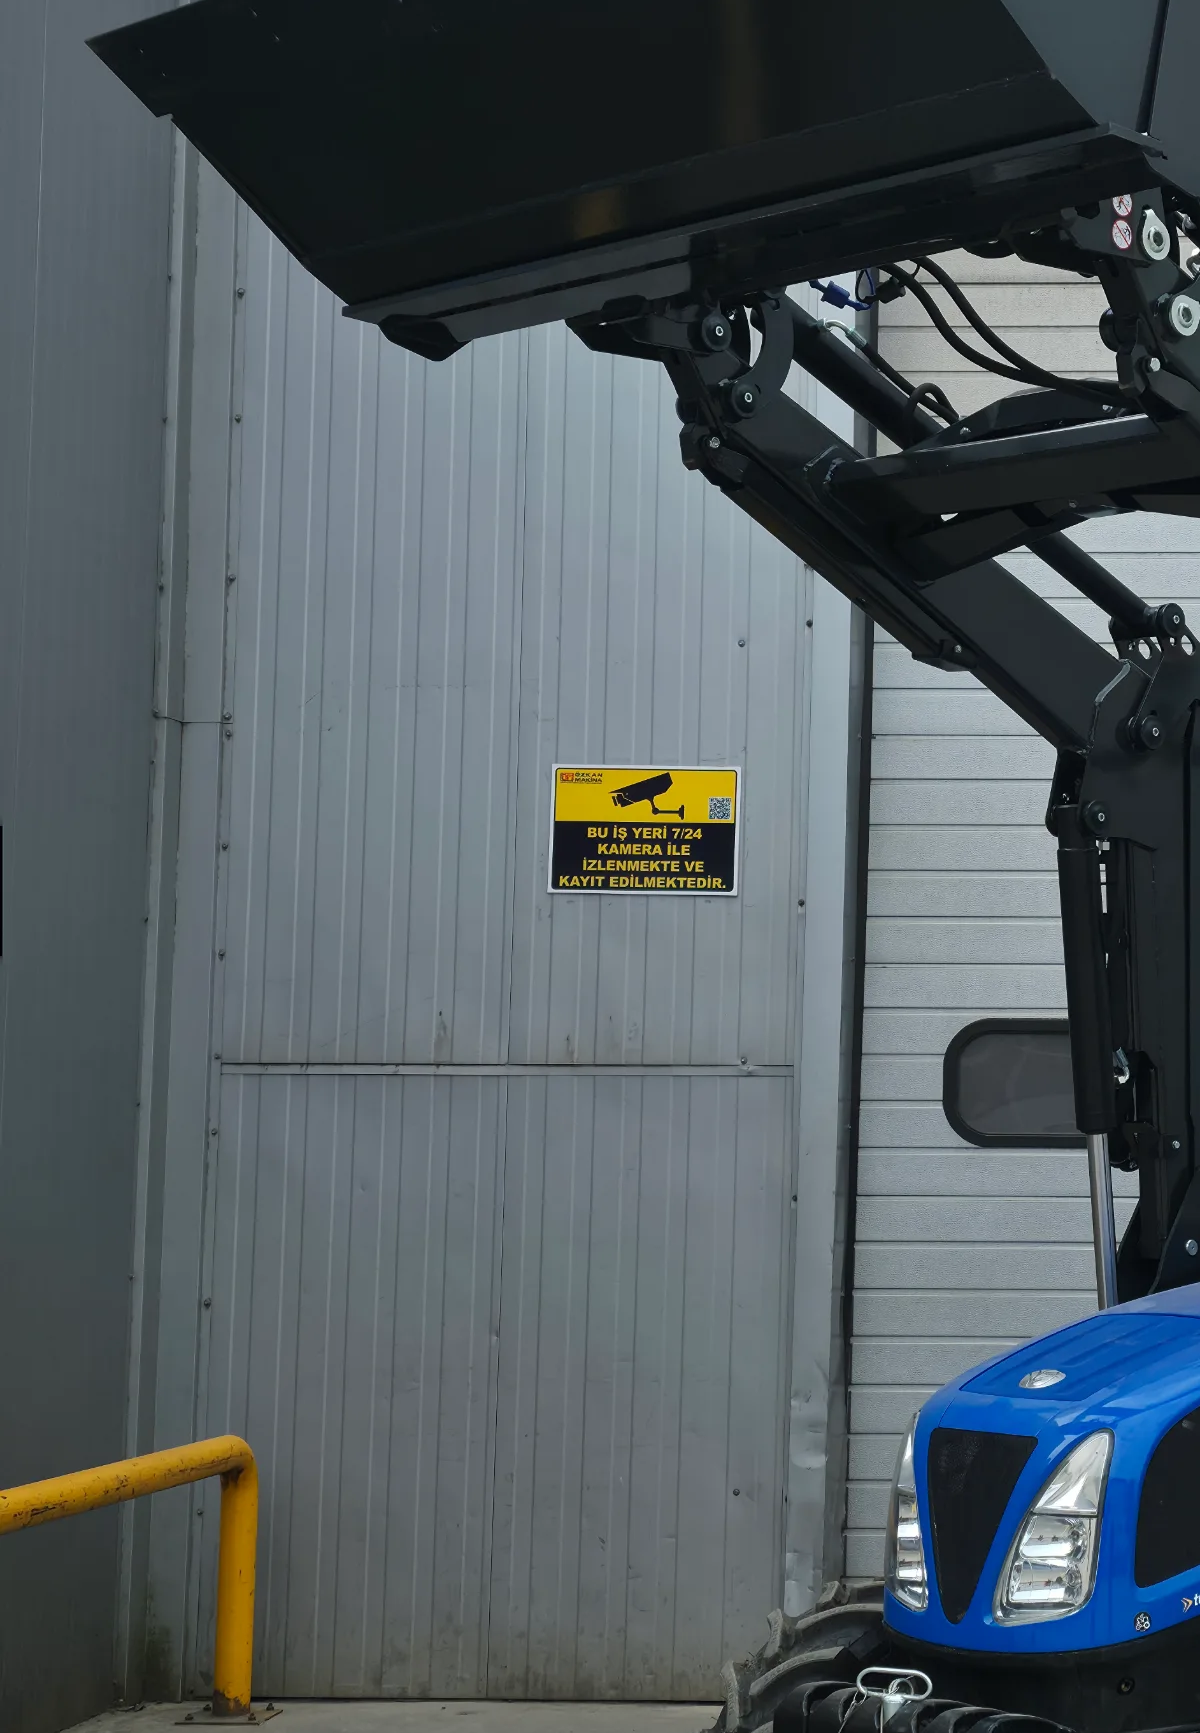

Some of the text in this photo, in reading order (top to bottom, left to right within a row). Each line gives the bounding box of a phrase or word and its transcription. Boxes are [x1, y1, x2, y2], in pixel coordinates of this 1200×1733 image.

[587, 824, 703, 841] BU İŞ YERİ 7/24
[597, 841, 691, 856] KAMERA İLE
[582, 857, 705, 872] İZLENMEKTE VE
[559, 874, 726, 889] KAYIT EDİLMEKTEDİR.
